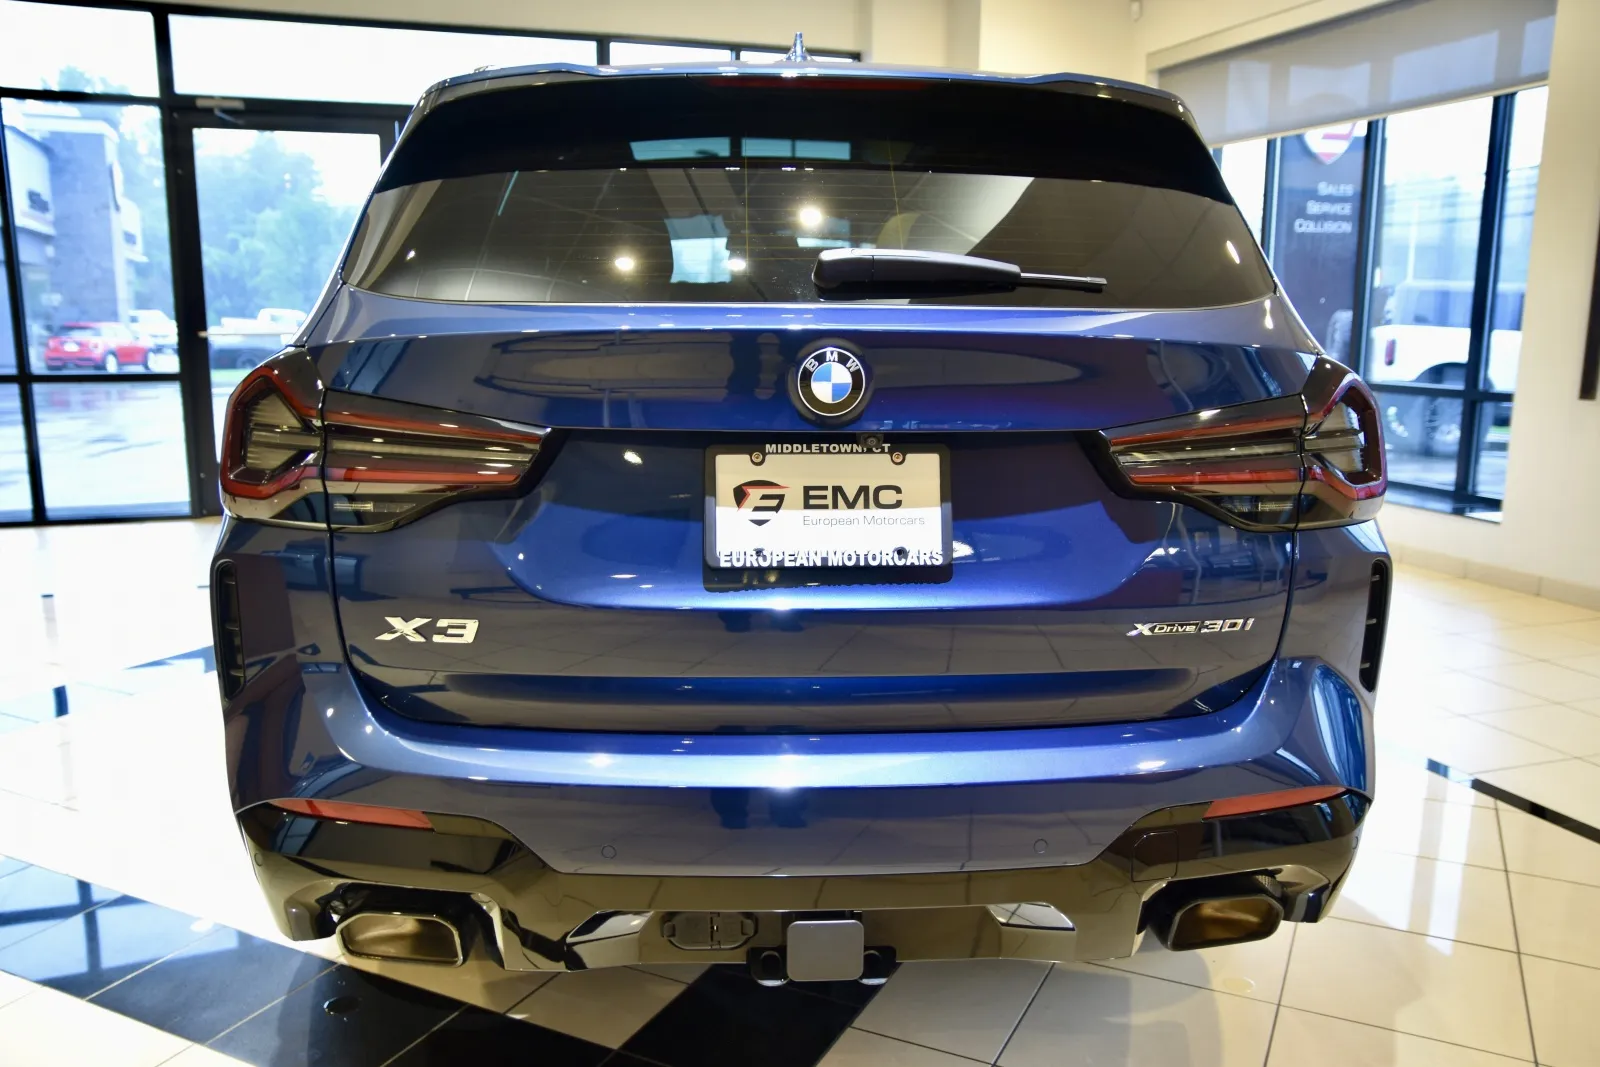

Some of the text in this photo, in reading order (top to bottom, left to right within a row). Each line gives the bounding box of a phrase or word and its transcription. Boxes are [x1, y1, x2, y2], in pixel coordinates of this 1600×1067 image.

[805, 350, 860, 373] BMW
[803, 485, 903, 510] EMC
[803, 515, 925, 527] European Motorcars
[719, 549, 944, 567] EUROPEAN MOTORCARS
[374, 616, 480, 644] X3
